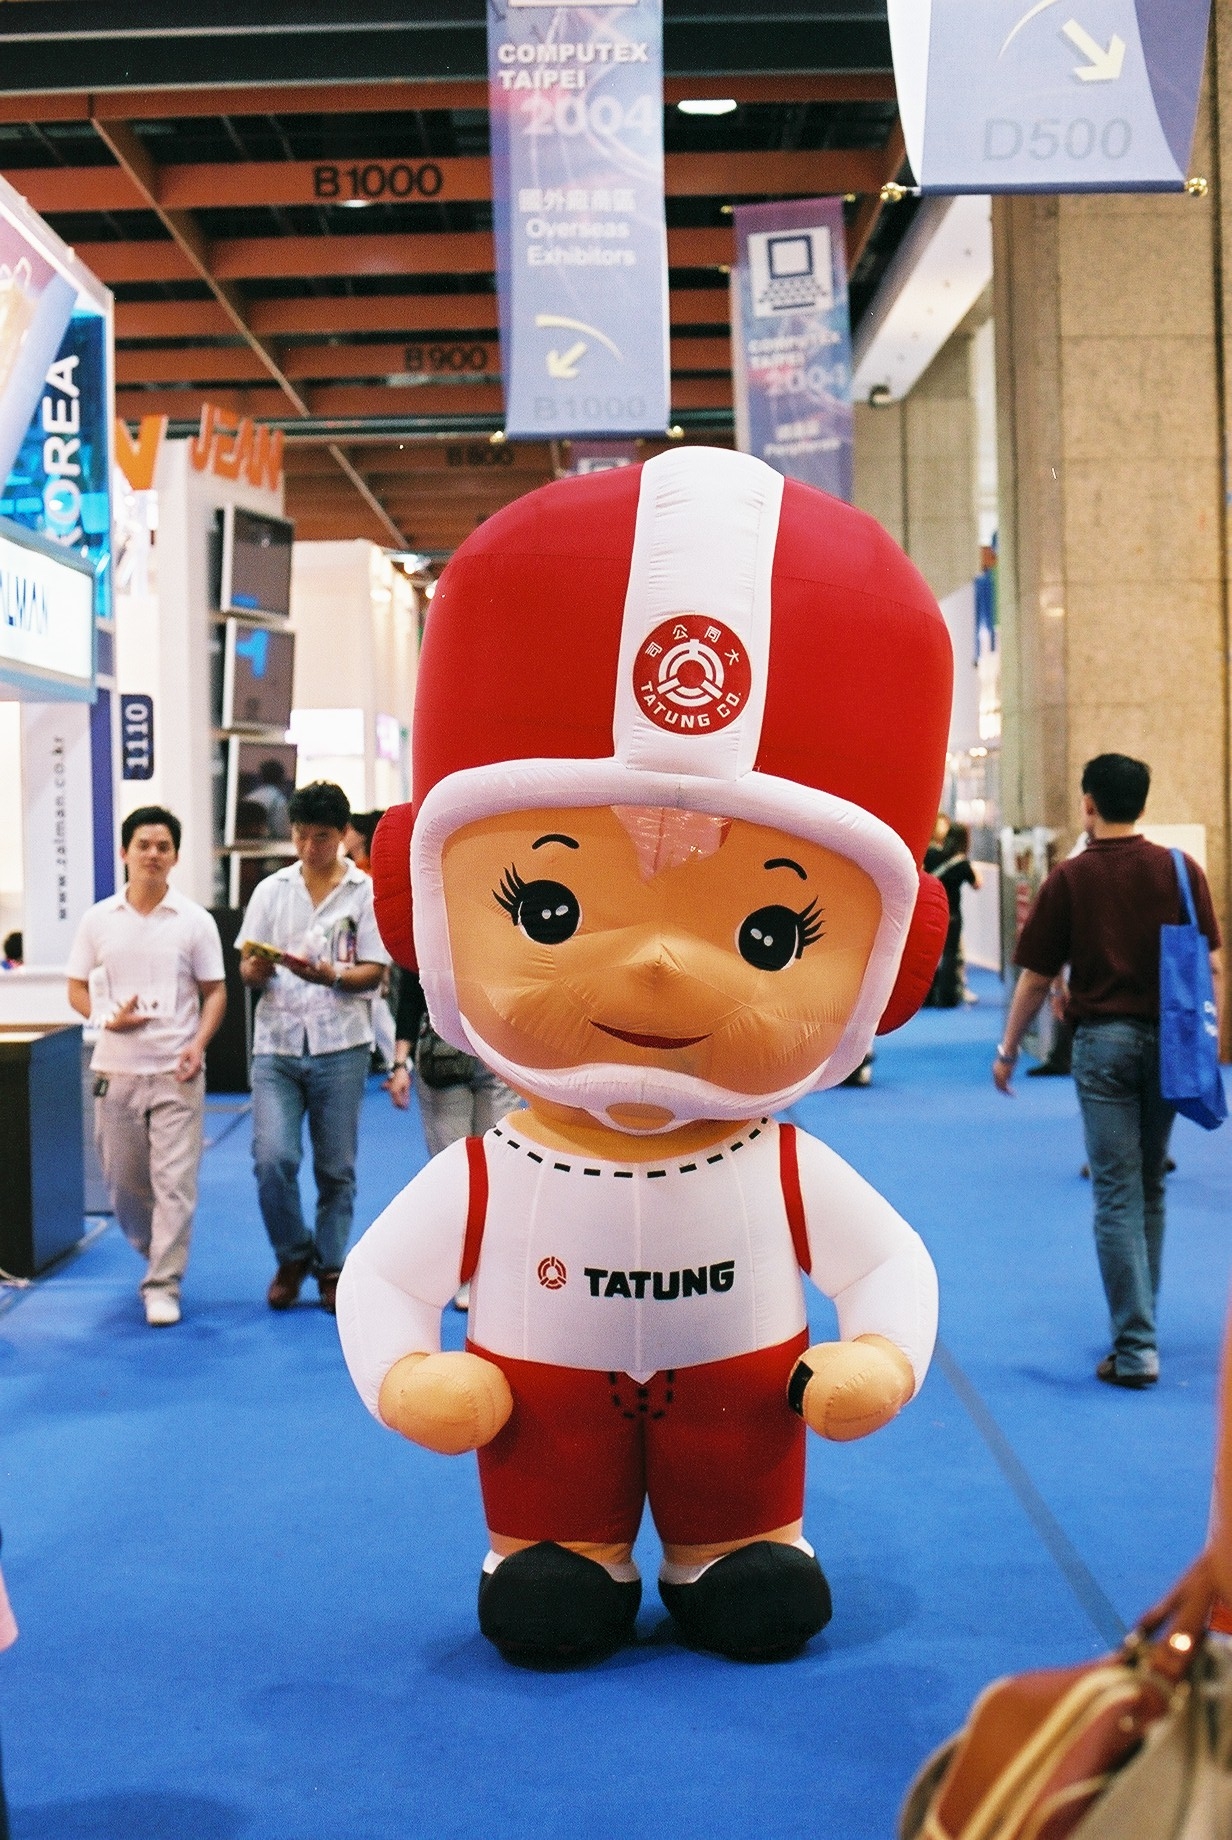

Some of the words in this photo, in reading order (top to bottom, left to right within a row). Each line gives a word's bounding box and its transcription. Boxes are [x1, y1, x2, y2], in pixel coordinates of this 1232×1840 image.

[498, 43, 649, 65] COMPUTEX
[498, 69, 587, 90] TAIPEI
[520, 94, 658, 135] 2004
[983, 117, 1132, 161] D500
[313, 164, 444, 198] B1000
[526, 218, 631, 239] Overseas
[527, 245, 637, 267] Exhibitors
[404, 347, 488, 371] B900
[533, 395, 648, 421] B1000
[189, 402, 285, 492] JEAN
[641, 680, 711, 729] TATUNG
[125, 702, 150, 770] 1110
[584, 1260, 736, 1301] TATUNG
